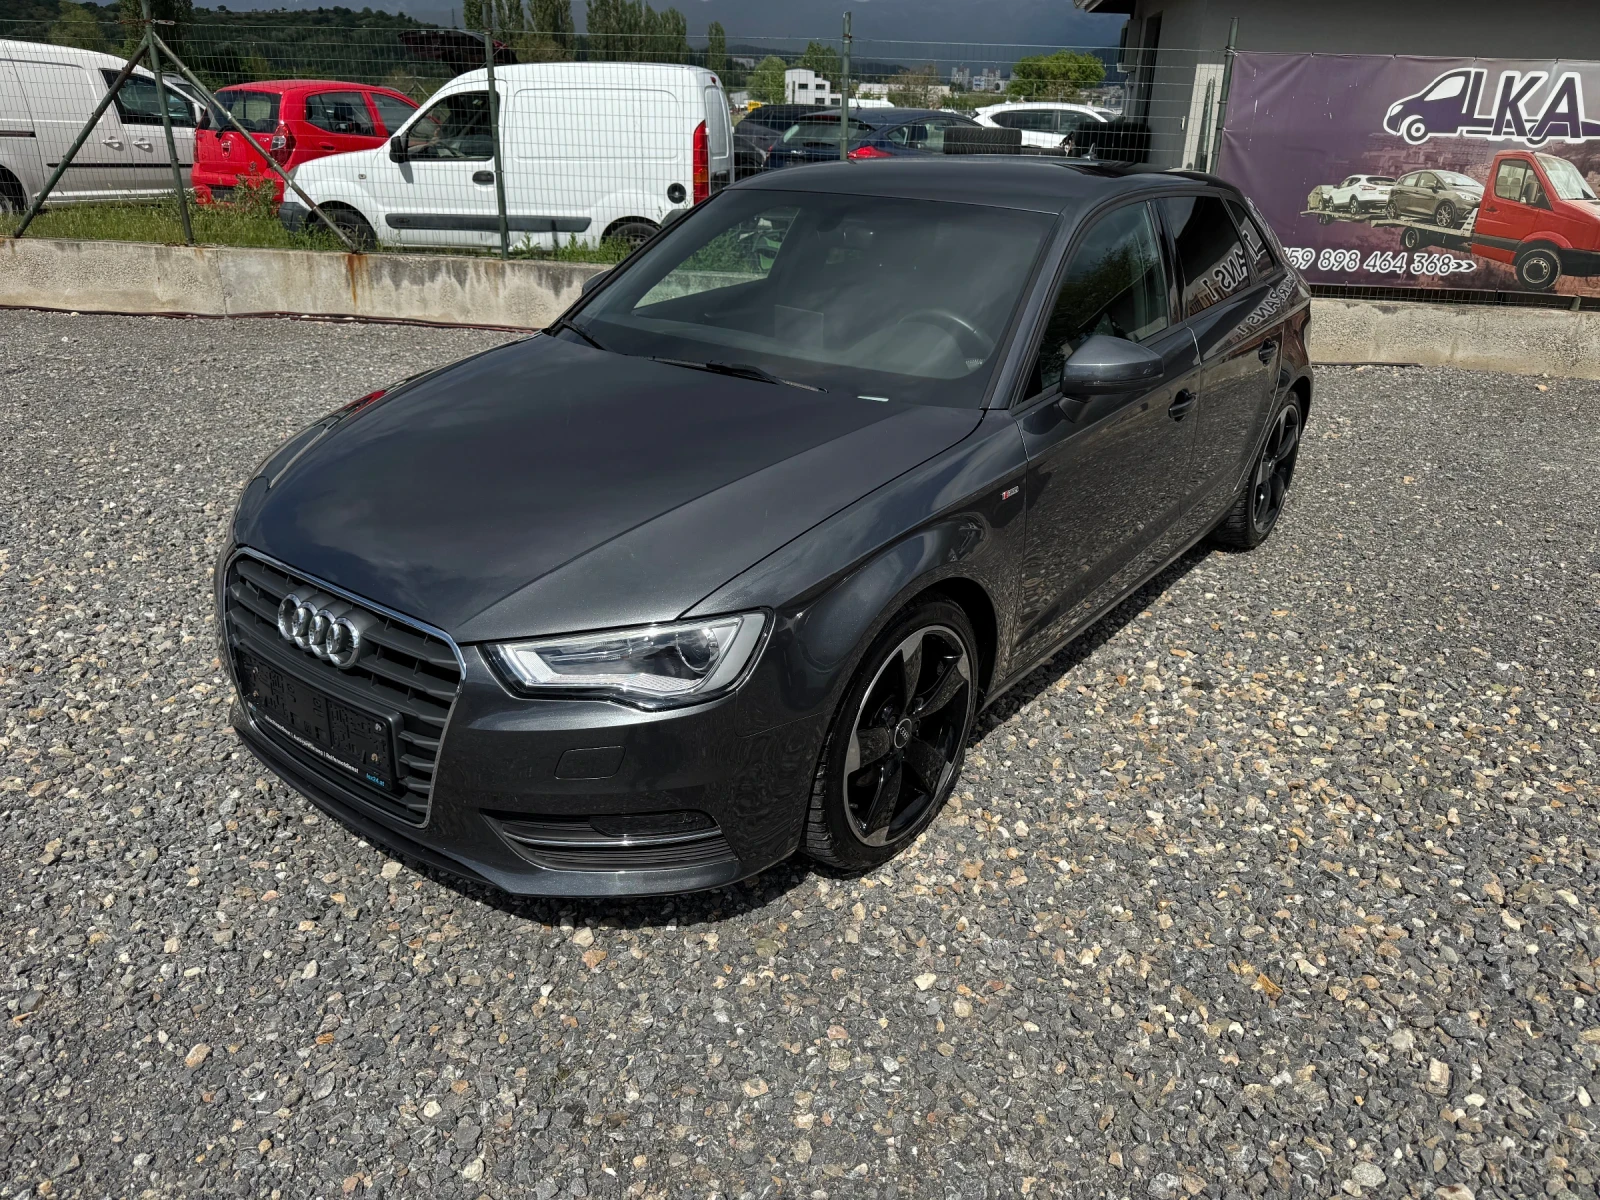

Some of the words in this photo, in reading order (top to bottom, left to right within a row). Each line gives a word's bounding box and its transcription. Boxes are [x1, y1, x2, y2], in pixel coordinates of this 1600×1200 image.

[1317, 248, 1361, 272] 898
[1363, 251, 1408, 273] 464
[1411, 252, 1453, 275] 368
